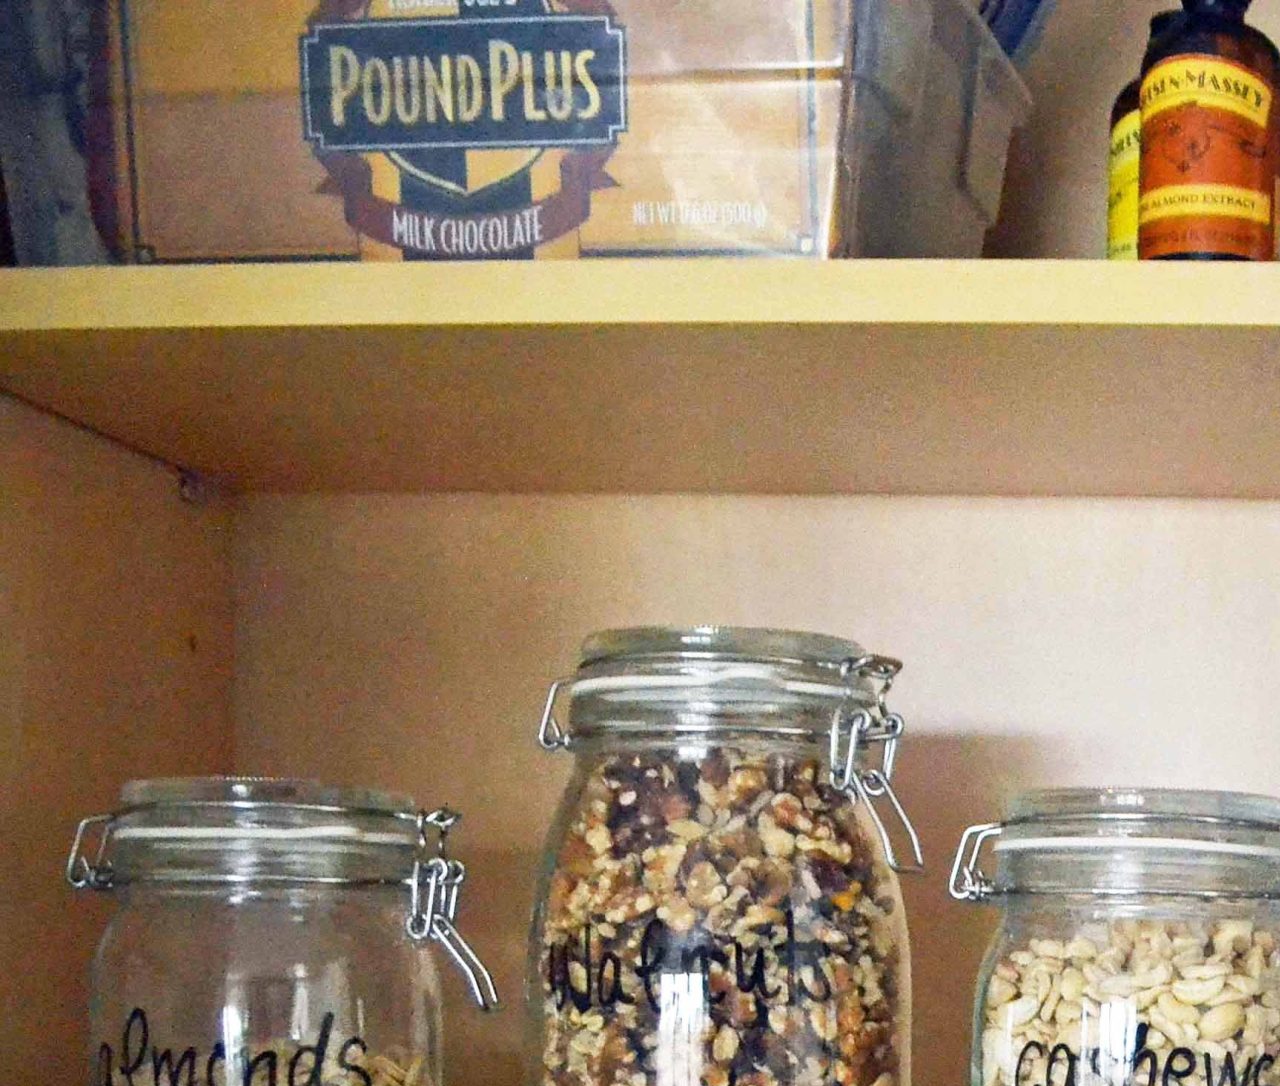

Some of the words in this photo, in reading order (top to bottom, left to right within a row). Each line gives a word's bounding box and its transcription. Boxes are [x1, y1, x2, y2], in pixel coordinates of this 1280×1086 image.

[1151, 193, 1199, 210] ALMOND
[1203, 191, 1255, 211] EXTRACT
[392, 208, 436, 251] MILK
[440, 206, 544, 255] CHOCOLATE
